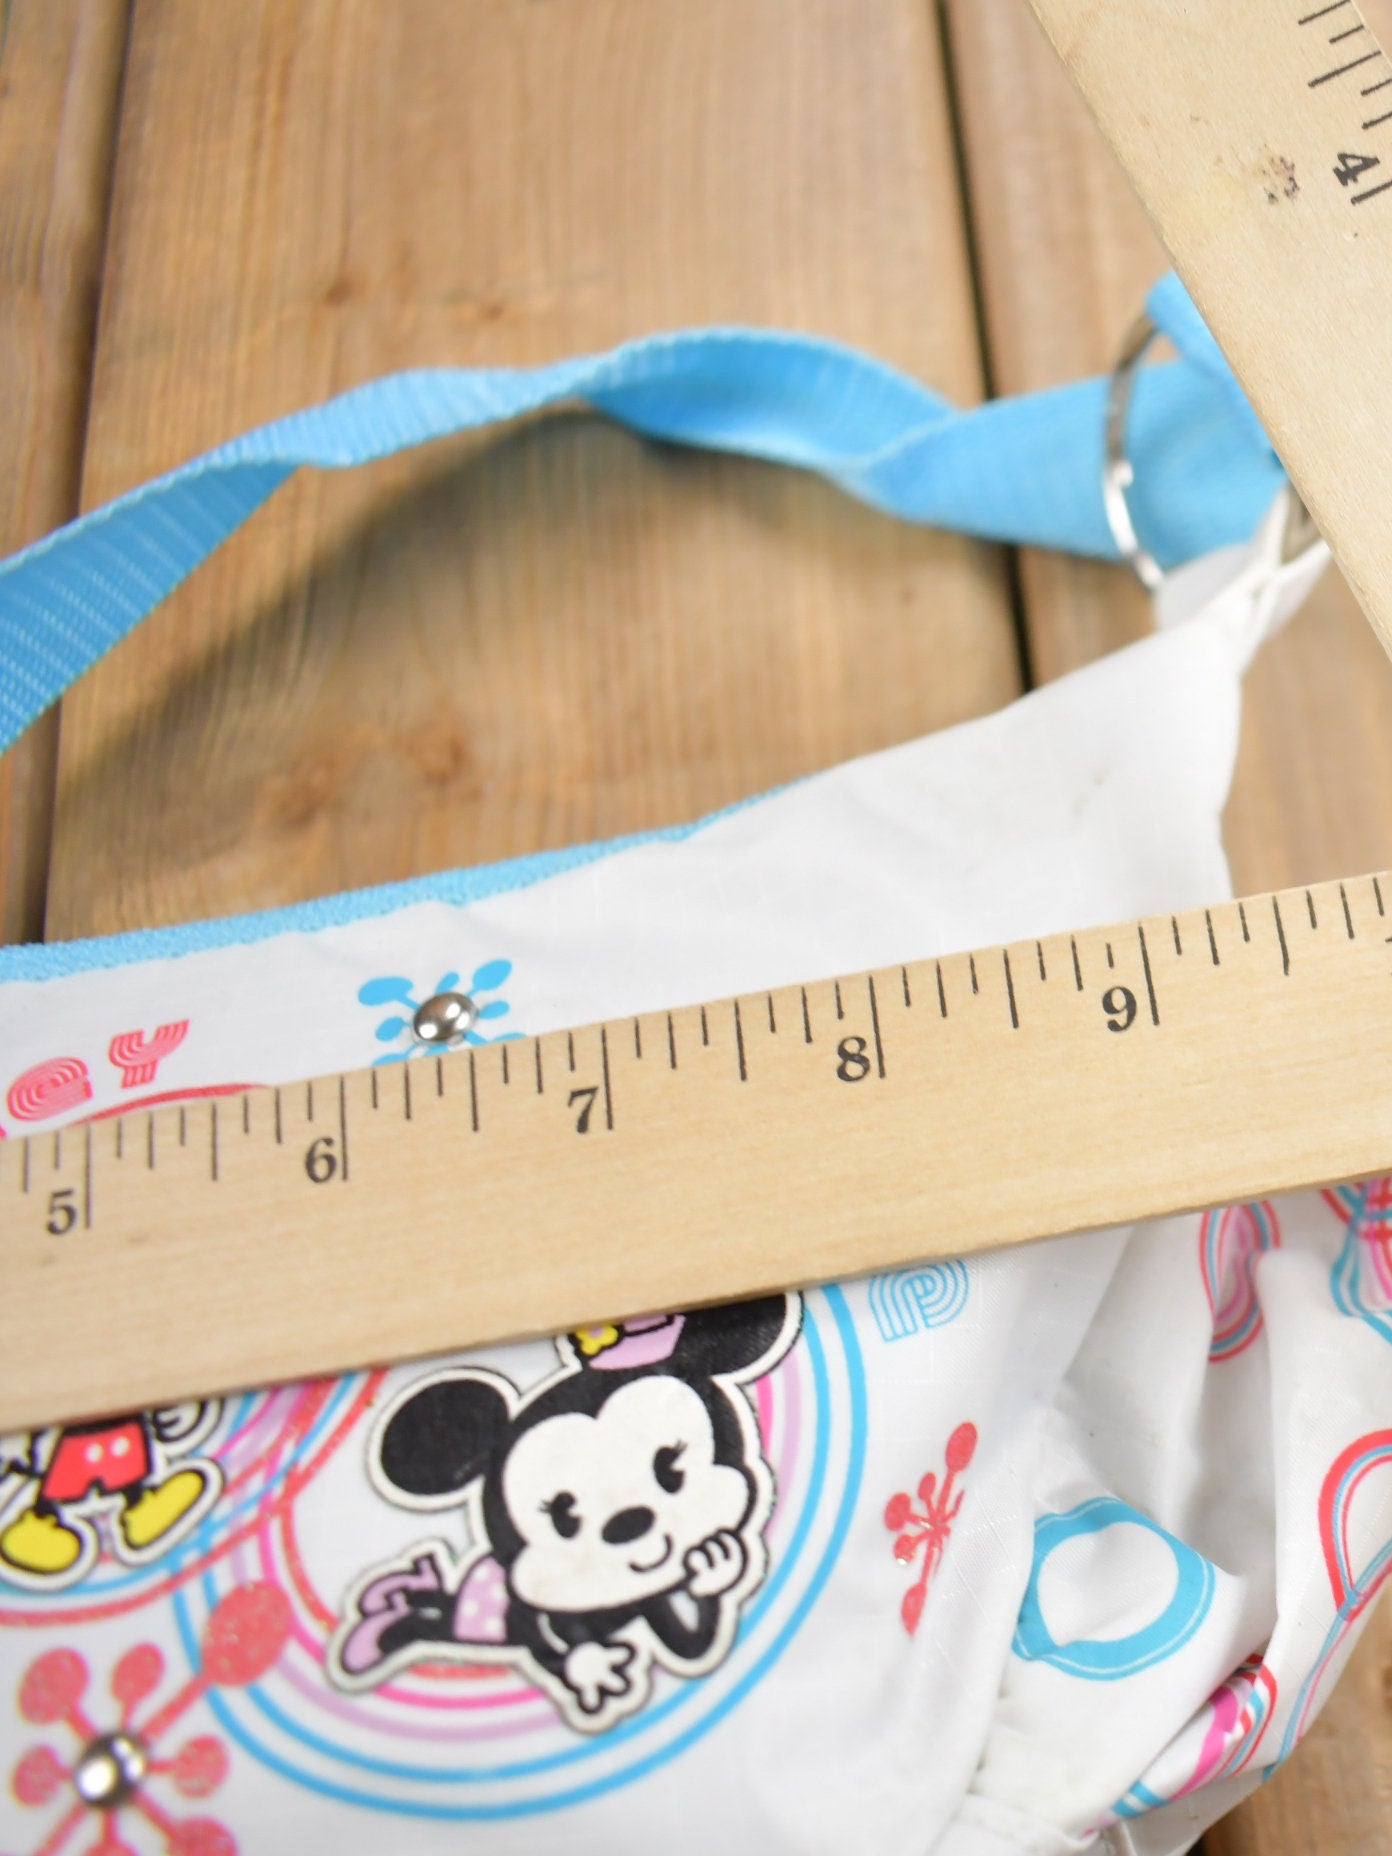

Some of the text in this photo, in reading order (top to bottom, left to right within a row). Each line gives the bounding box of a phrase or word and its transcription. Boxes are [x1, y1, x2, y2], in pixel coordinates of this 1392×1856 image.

[1332, 151, 1380, 186] 4
[46, 1188, 77, 1235] 5
[304, 1137, 338, 1183] 6
[566, 1087, 600, 1134] 7
[836, 1036, 871, 1083] 8
[1101, 987, 1137, 1033] 9
